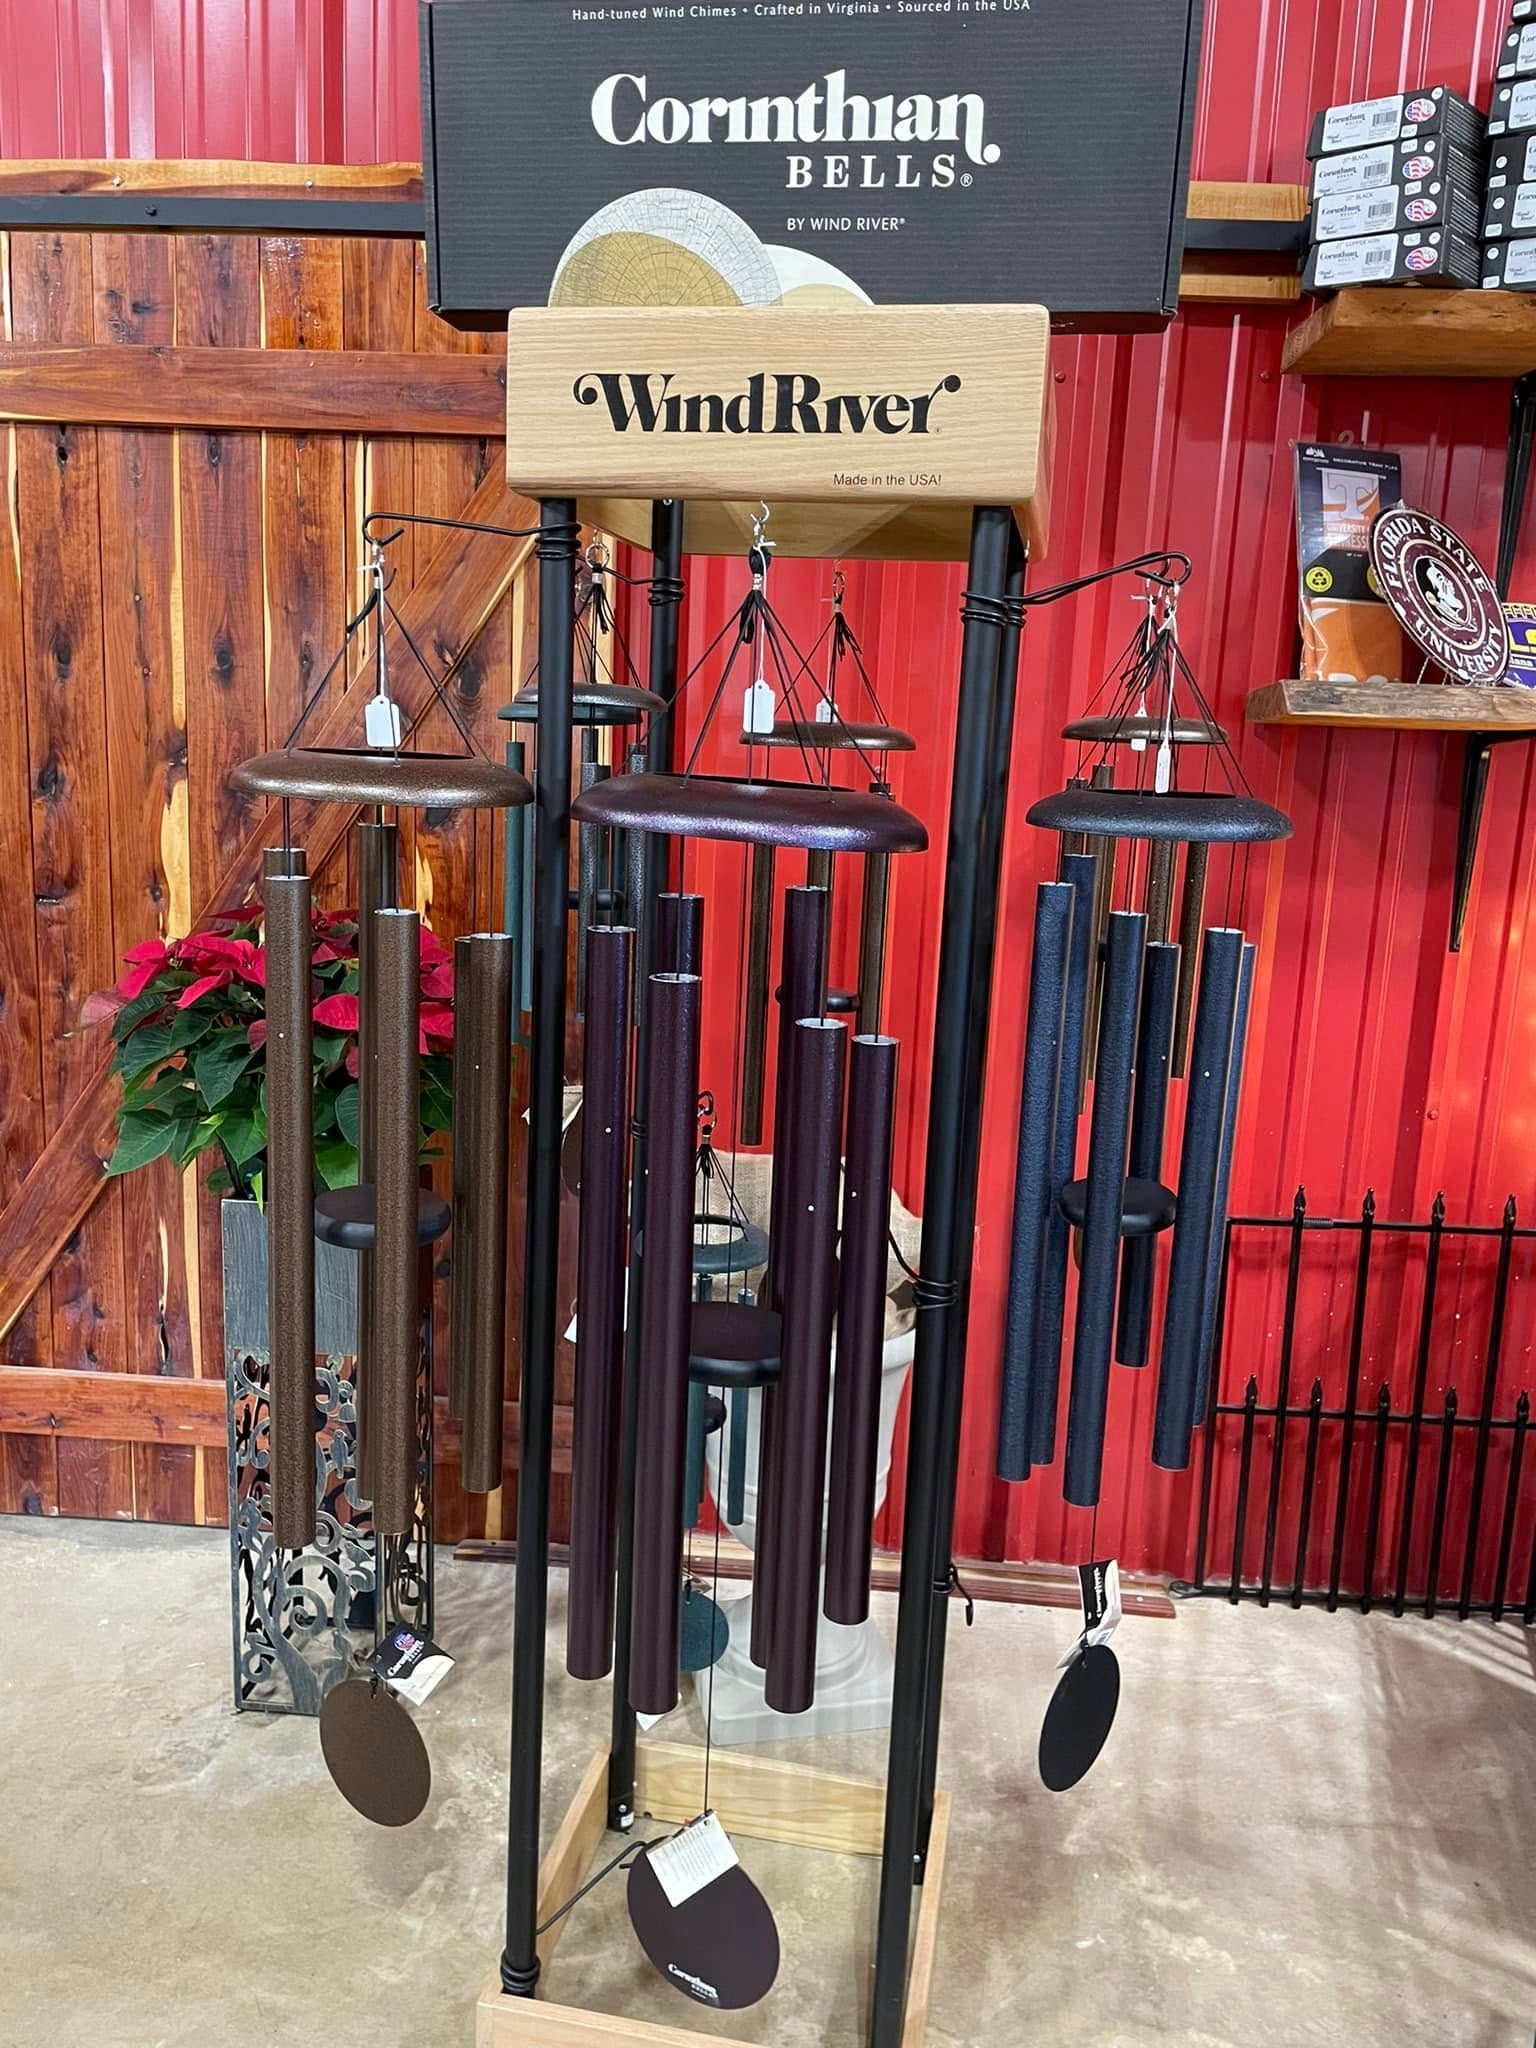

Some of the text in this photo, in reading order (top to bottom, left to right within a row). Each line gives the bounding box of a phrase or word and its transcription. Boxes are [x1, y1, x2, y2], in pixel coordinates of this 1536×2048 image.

[572, 0, 1031, 21] Hand-tuned Wind Chimes Crafted in Virginia Sourced in the USA
[591, 68, 1001, 166] Corinthian
[786, 217, 807, 231] BY
[810, 217, 852, 231] WIND
[833, 473, 942, 487] Made in the USA!
[1380, 517, 1503, 674] FLORIDA STATE UNIVERSITY
